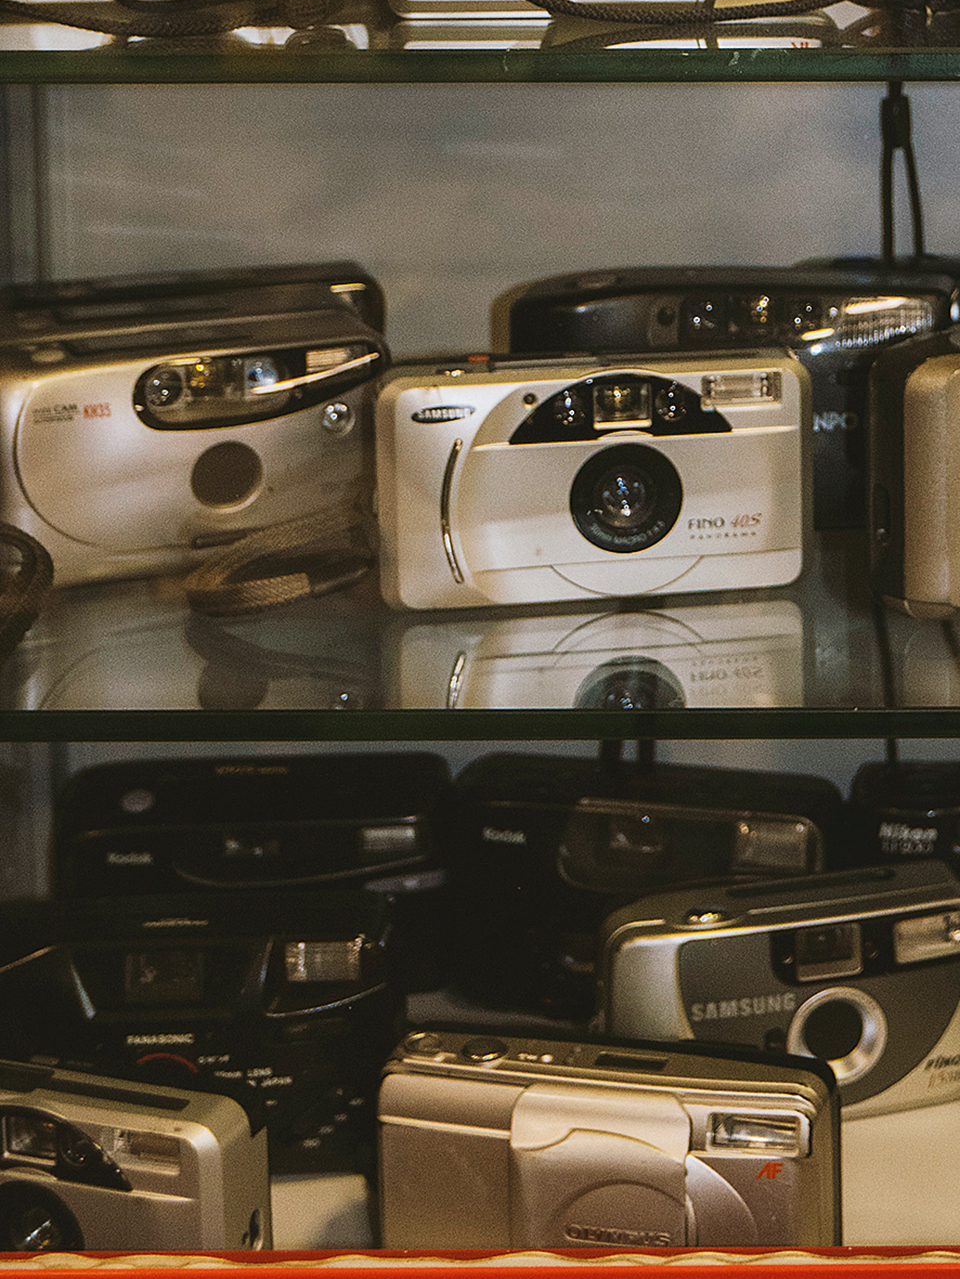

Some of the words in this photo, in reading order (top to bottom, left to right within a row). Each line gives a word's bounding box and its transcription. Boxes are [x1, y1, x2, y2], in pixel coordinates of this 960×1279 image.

[418, 407, 471, 419] SAMSUNG
[687, 516, 726, 531] FINO
[690, 992, 797, 1021] SAMSUNG
[755, 1162, 784, 1179] AF
